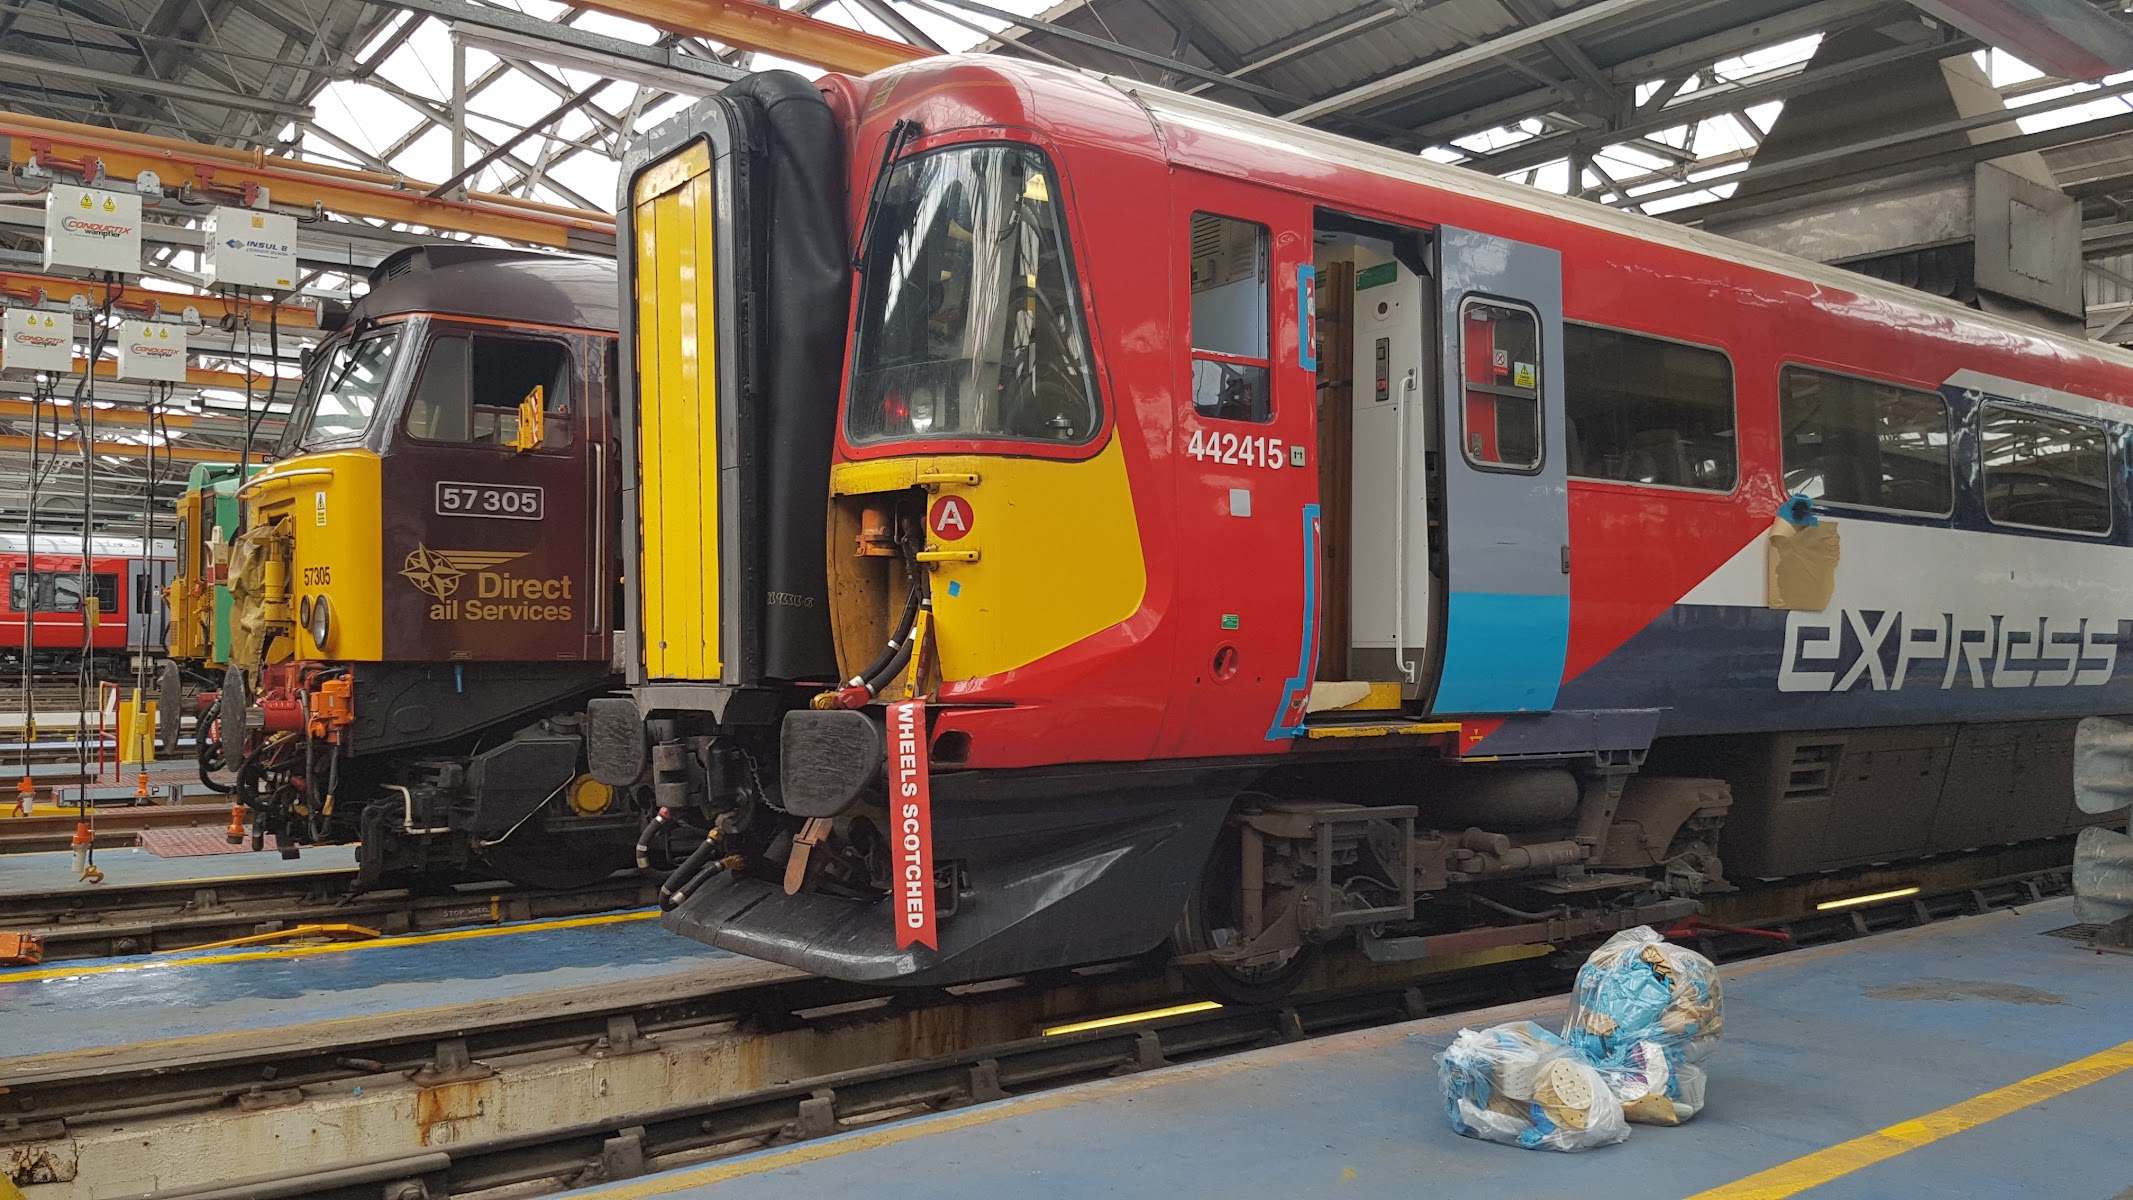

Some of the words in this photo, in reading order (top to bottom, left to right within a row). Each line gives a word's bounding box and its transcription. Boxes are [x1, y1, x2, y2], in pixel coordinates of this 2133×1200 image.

[67, 220, 133, 234] CONDUCTIX
[84, 229, 121, 239] wampfler
[246, 240, 278, 250] INSUL
[18, 334, 66, 344] CONDUCTIX
[135, 346, 181, 355] CONDUCTIX
[1187, 430, 1284, 470] 442415
[443, 488, 478, 511] 57
[482, 489, 538, 514] 305
[937, 500, 966, 532] A
[303, 566, 331, 587] 57305
[478, 572, 573, 600] Direct
[464, 599, 573, 622] Services
[897, 703, 918, 798] WHEELS
[901, 803, 925, 930] SCOTCHED
[443, 908, 465, 917] STOP
